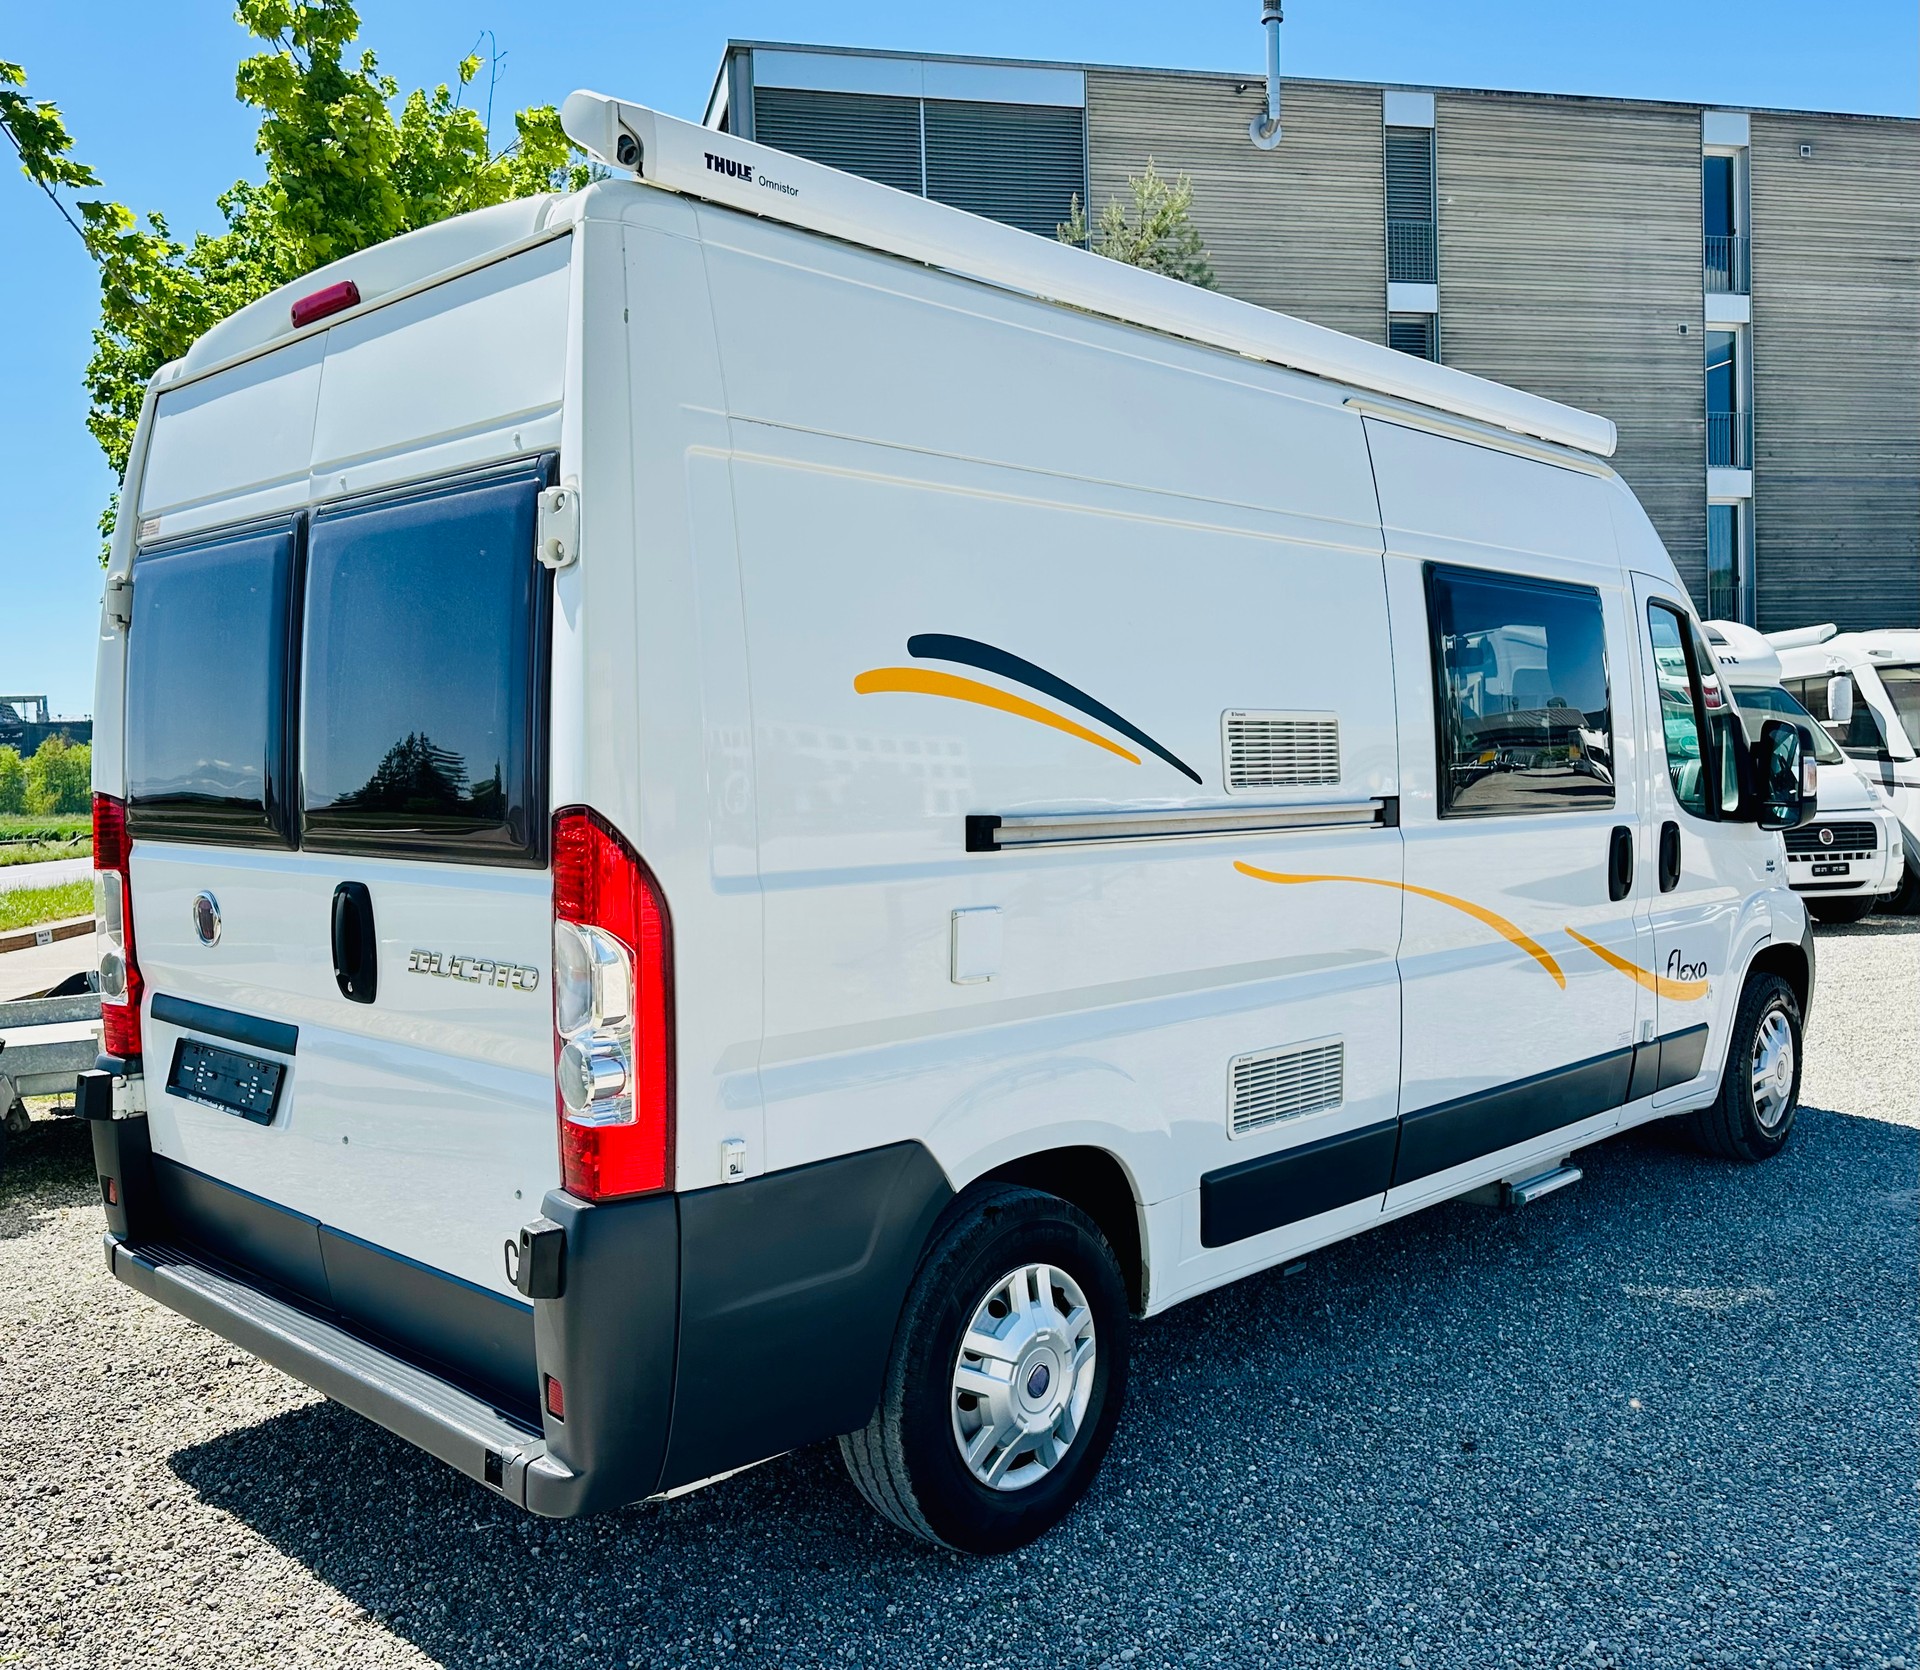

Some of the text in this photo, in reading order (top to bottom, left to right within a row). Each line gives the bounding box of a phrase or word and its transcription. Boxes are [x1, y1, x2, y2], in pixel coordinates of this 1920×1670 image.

[704, 152, 799, 197] THULE Omnistor
[408, 948, 540, 993] DUCATO
